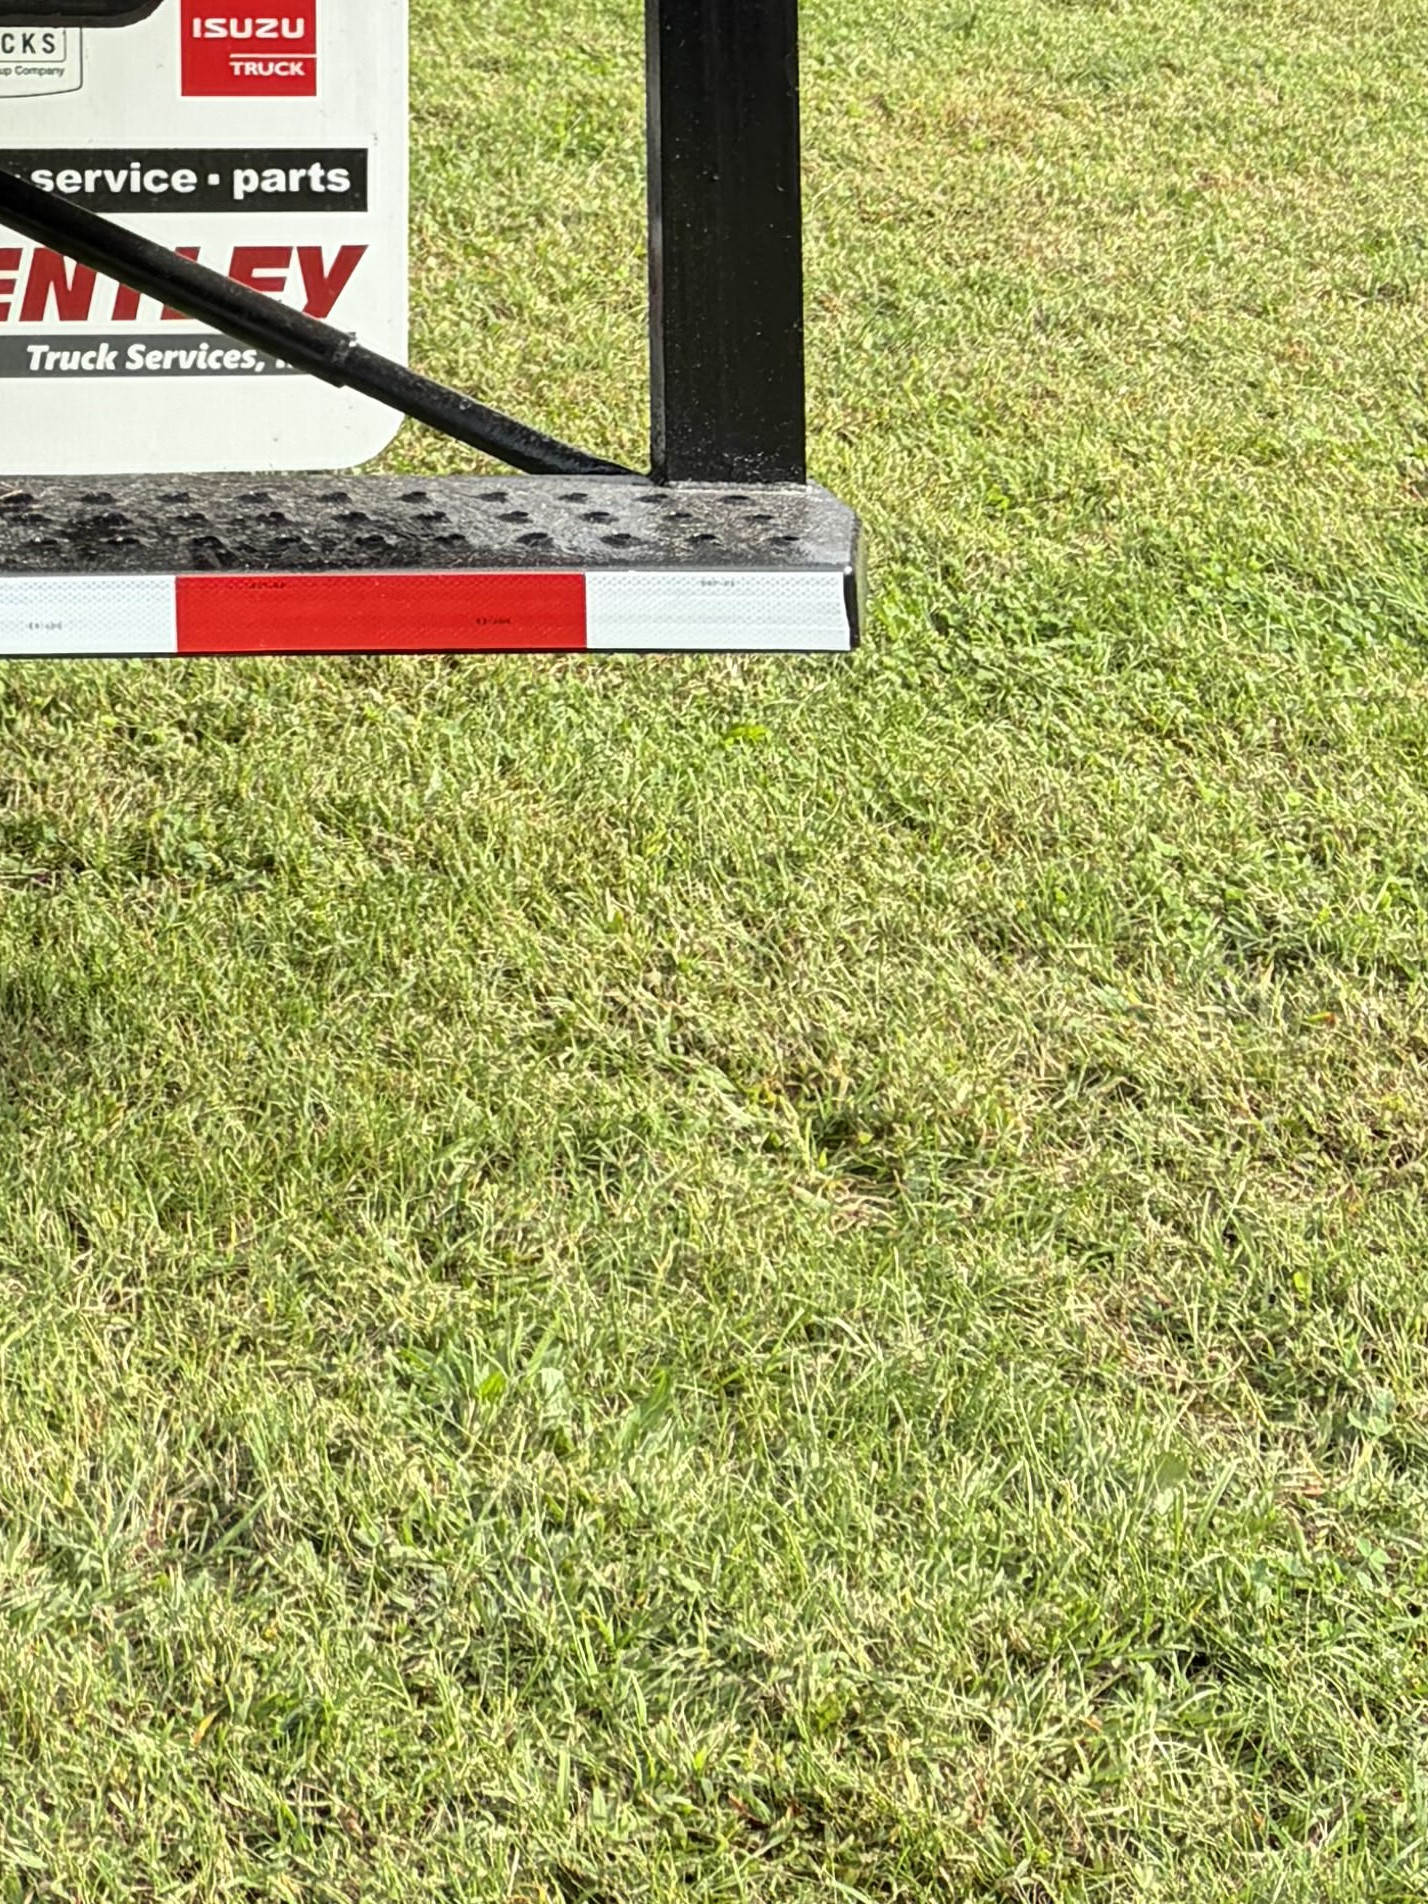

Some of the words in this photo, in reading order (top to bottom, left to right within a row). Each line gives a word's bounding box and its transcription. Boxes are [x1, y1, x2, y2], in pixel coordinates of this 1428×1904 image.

[192, 16, 306, 40] ISUZU
[15, 65, 65, 77] Company
[230, 60, 306, 77] TRUCK
[31, 162, 198, 193] service
[233, 162, 351, 200] parts
[27, 343, 116, 372] Truck
[125, 344, 265, 373] Services,
